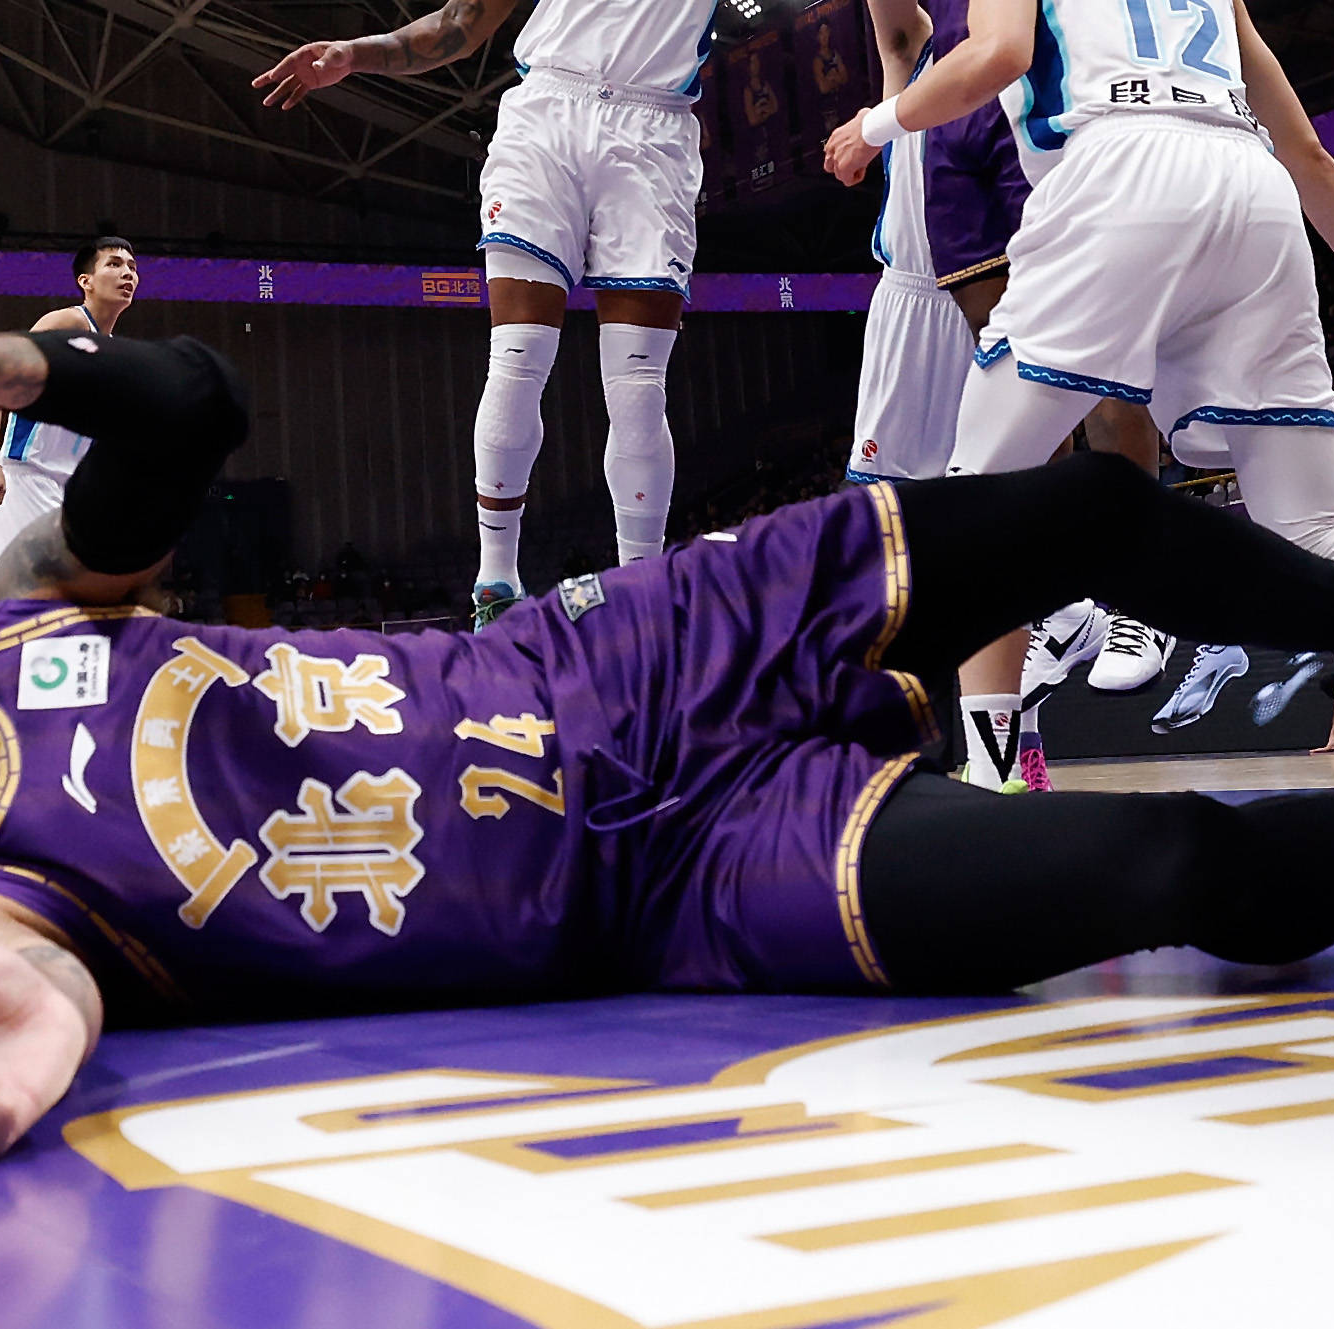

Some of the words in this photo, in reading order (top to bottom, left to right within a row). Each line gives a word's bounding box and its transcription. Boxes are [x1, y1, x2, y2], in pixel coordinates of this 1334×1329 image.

[258, 265, 274, 300] 北京
[422, 279, 481, 295] BG北控
[778, 276, 794, 308] 北京
[143, 665, 213, 869] 紫禁勇士
[251, 641, 426, 937] 北京
[453, 712, 566, 820] 24
